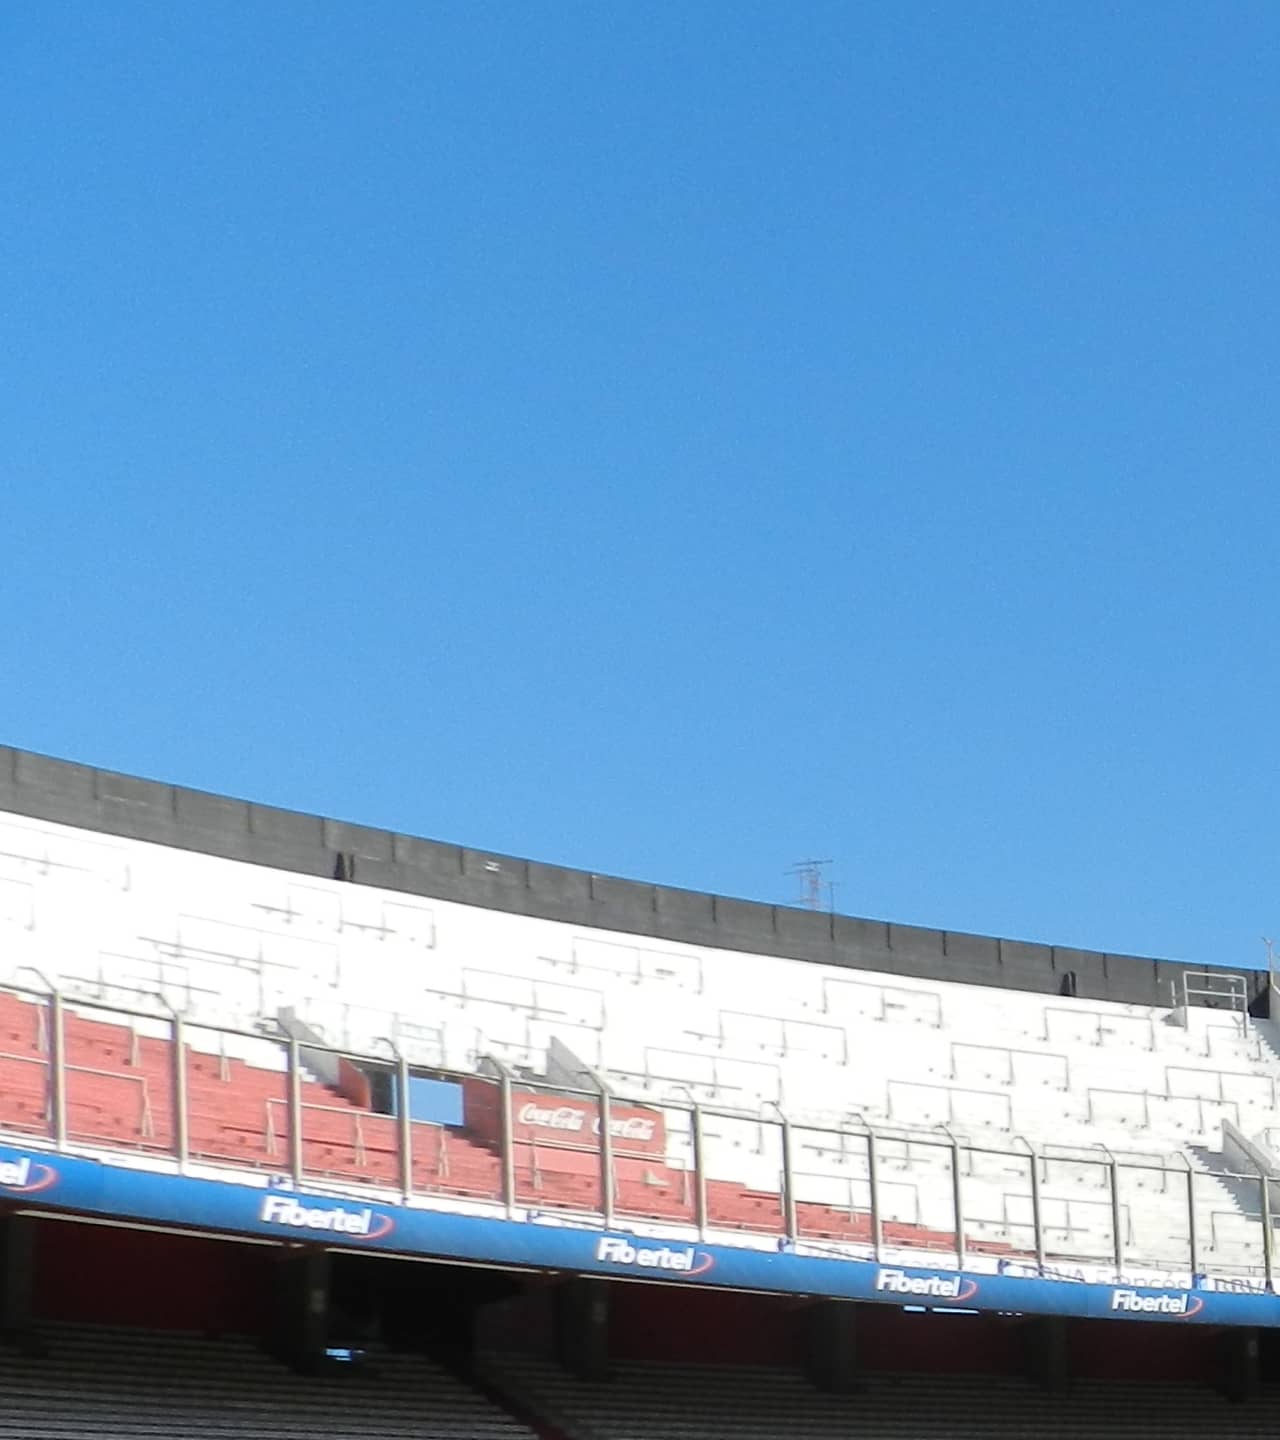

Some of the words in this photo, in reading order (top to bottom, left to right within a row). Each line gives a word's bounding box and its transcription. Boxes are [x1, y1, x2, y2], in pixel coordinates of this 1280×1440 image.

[260, 1194, 372, 1234] Fibertel
[596, 1236, 696, 1270] Fibertel
[876, 1269, 960, 1297] Fibertel
[1112, 1289, 1189, 1314] Fibertel
